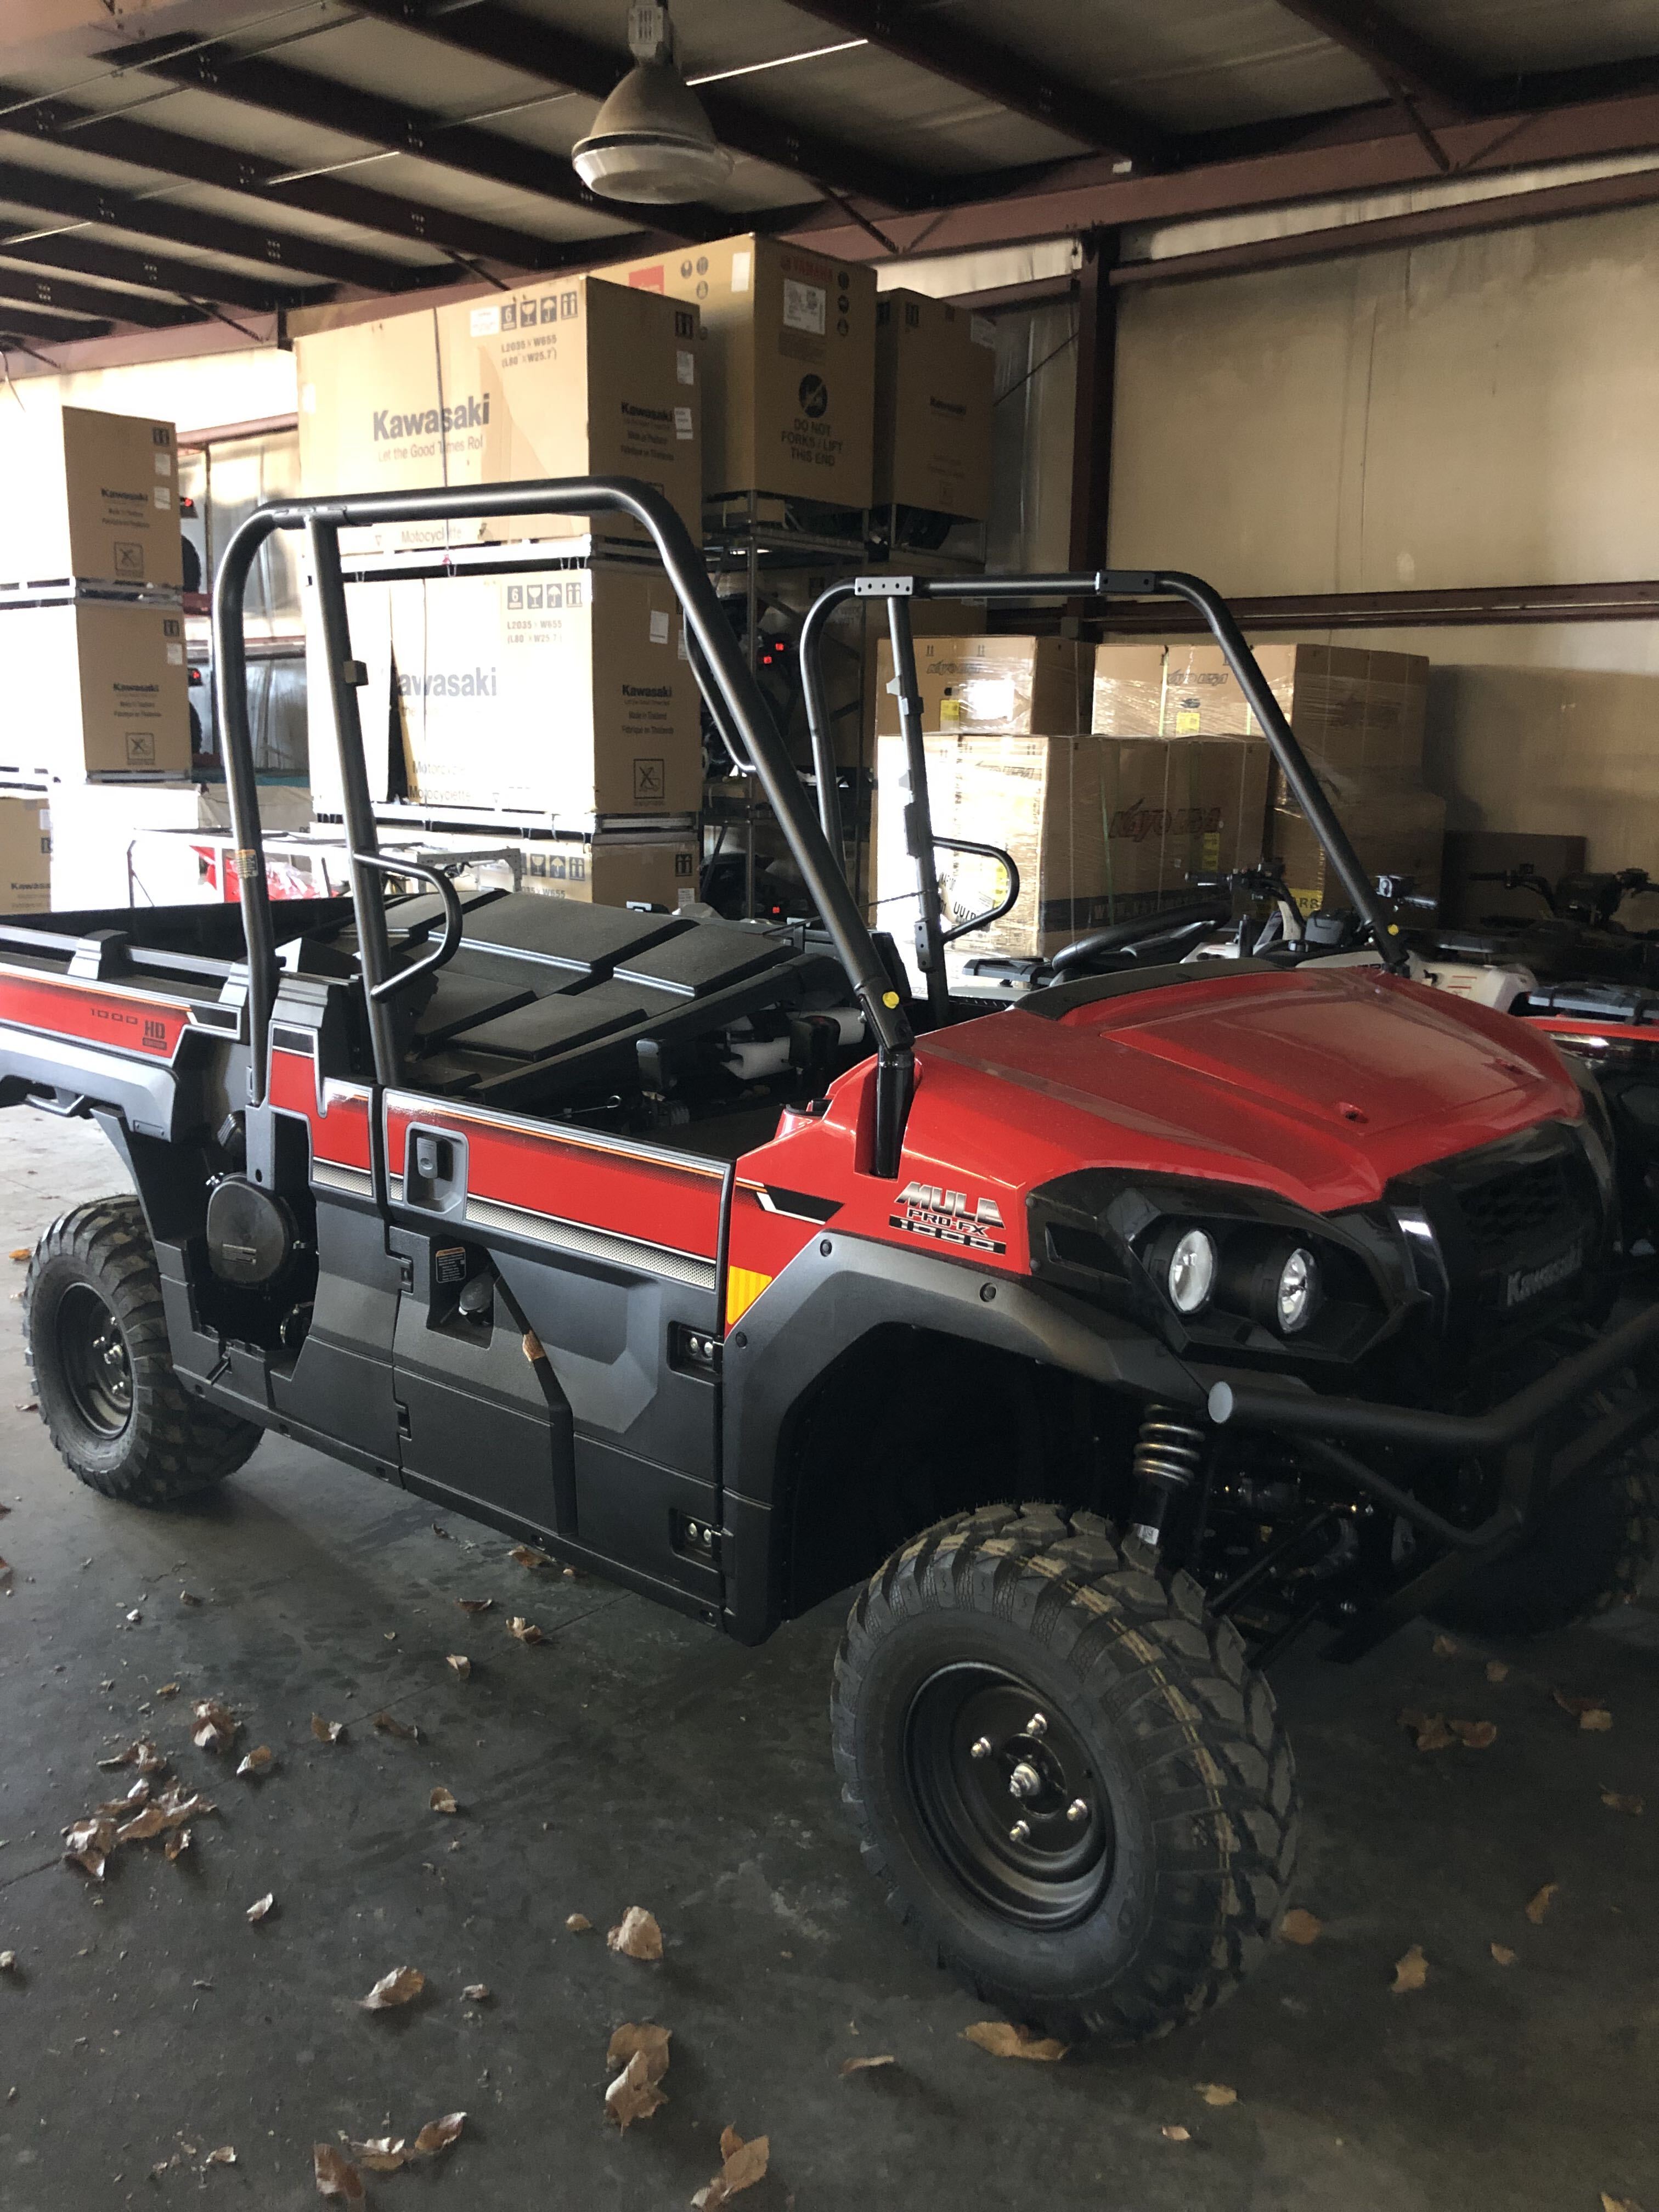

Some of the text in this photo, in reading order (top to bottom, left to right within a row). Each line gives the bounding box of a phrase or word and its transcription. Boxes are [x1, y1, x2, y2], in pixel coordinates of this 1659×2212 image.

[374, 393, 489, 442] Kawasaki
[794, 419, 809, 432] DO
[394, 447, 408, 460] the
[411, 443, 435, 458] Good
[438, 439, 465, 454] Tmes
[402, 527, 461, 544] Motocycltte
[507, 620, 532, 629] L2035
[540, 620, 562, 628] W655
[399, 667, 497, 697] awasaki
[622, 684, 672, 697] Kawasaki
[91, 1009, 165, 1039] 1000 HD
[906, 1207, 989, 1237] PRO-FX
[900, 1218, 995, 1252] 1000
